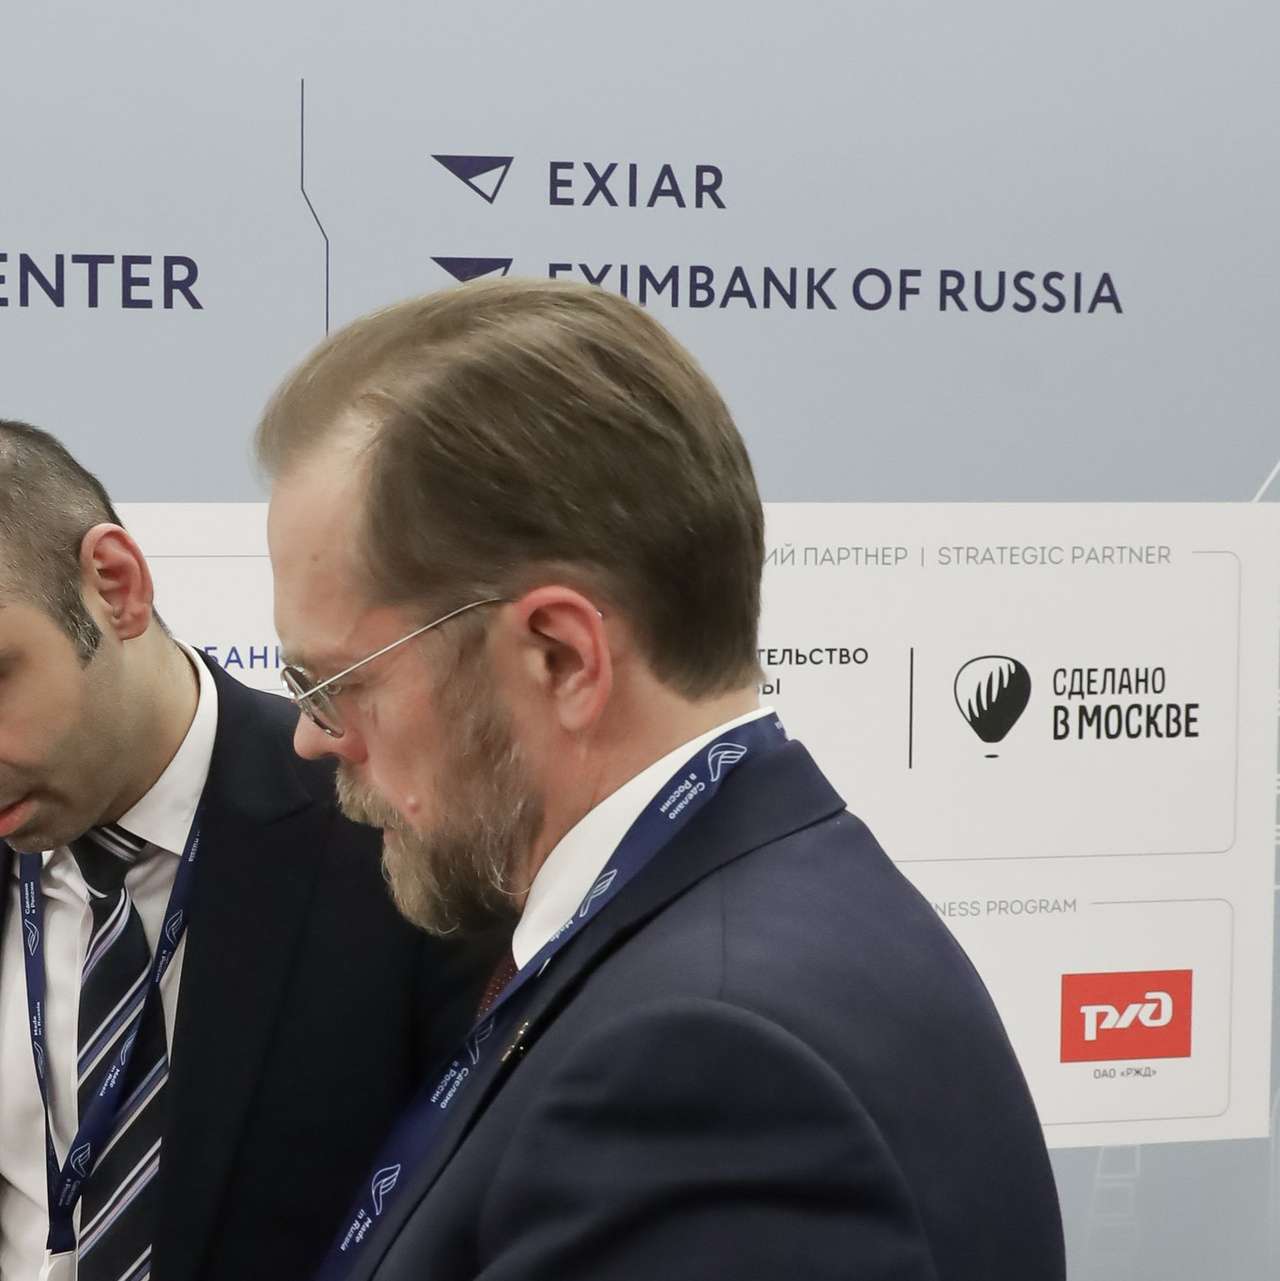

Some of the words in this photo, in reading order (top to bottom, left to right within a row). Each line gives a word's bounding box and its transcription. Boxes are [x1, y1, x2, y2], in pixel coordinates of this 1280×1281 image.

[549, 161, 728, 209] EXIAR
[852, 267, 922, 312] OF
[939, 269, 1124, 314] RUSSIA
[803, 547, 908, 566] ПАРТНЕР
[938, 545, 1064, 566] STRATEGIC
[1071, 545, 1172, 565] PARTNER
[1053, 667, 1166, 700] СДЕЛАНО
[1053, 705, 1070, 740] В
[1078, 703, 1199, 740] МОСКВЕ
[660, 779, 693, 813] России
[668, 781, 706, 820] Сделано
[986, 899, 1077, 916] PROGRAM
[430, 1068, 457, 1103] России
[440, 1067, 469, 1109] Сделано
[340, 1219, 360, 1251] Russia
[355, 1217, 372, 1243] Made
